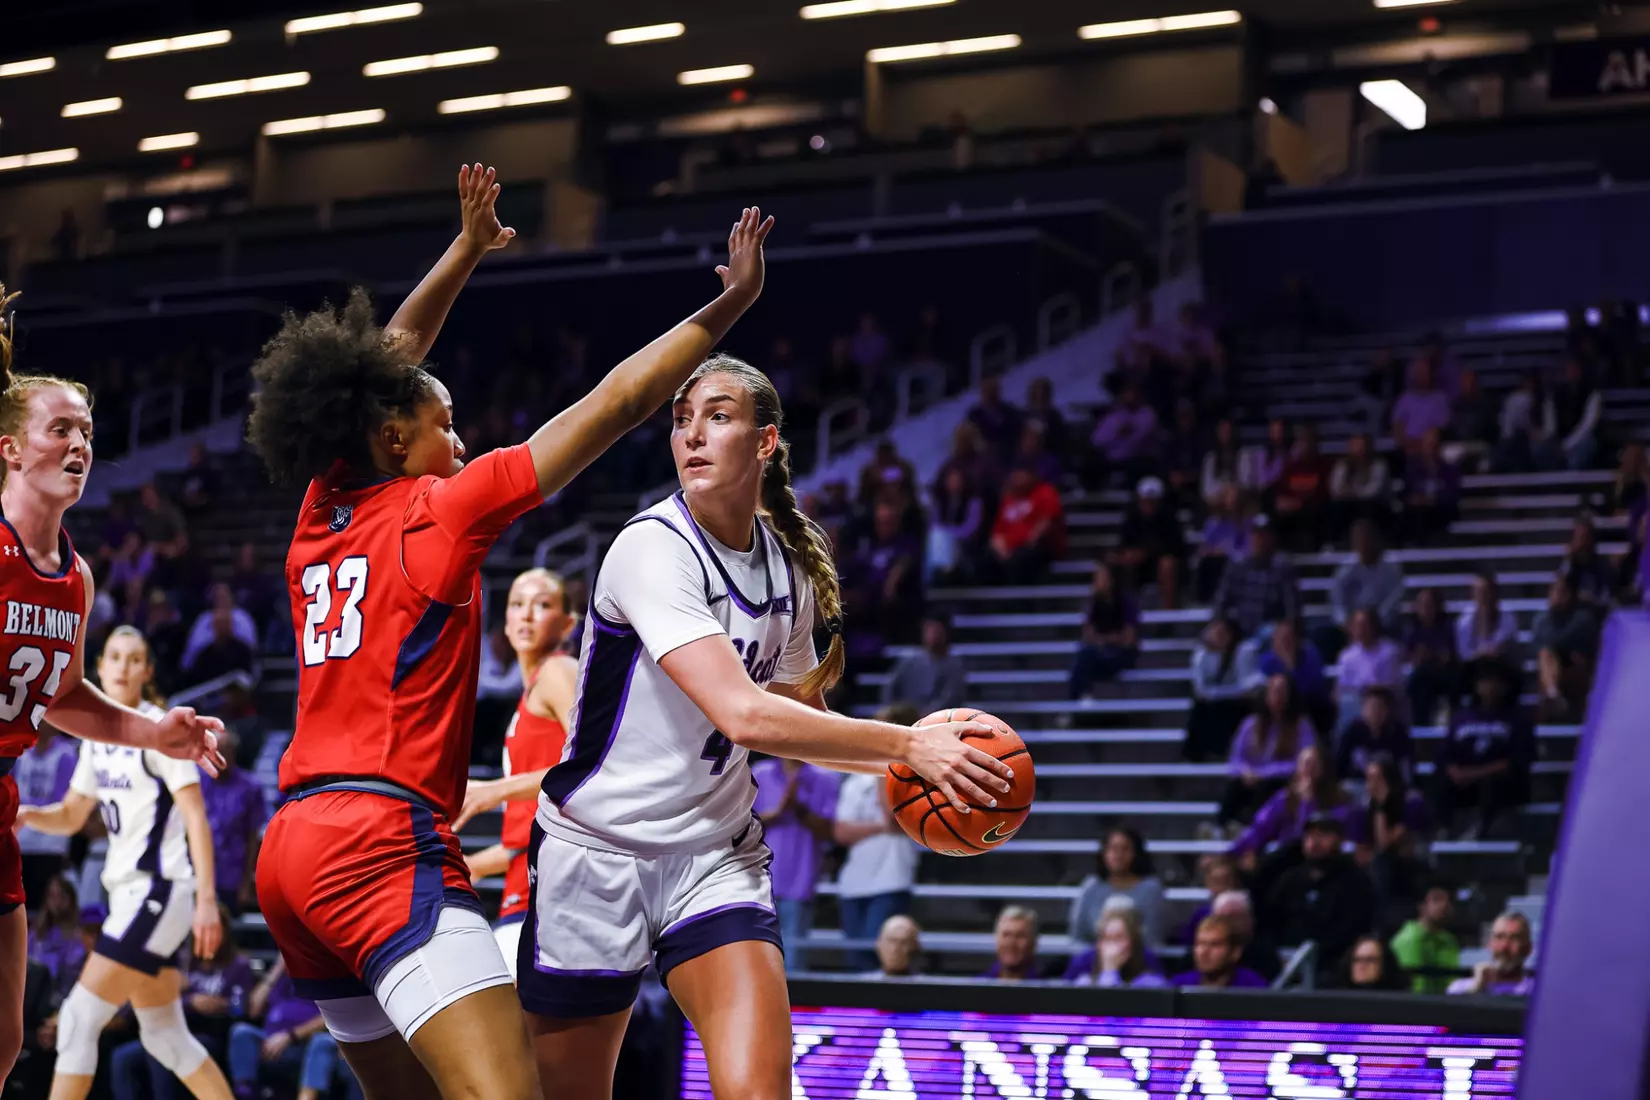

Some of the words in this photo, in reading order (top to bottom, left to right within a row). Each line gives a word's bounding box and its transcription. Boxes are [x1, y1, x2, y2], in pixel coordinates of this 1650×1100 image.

[4, 601, 81, 646] BELMONT
[301, 555, 370, 667] 23
[0, 646, 71, 731] 35
[700, 728, 735, 776] 4
[792, 1026, 1359, 1100] ANSAS
